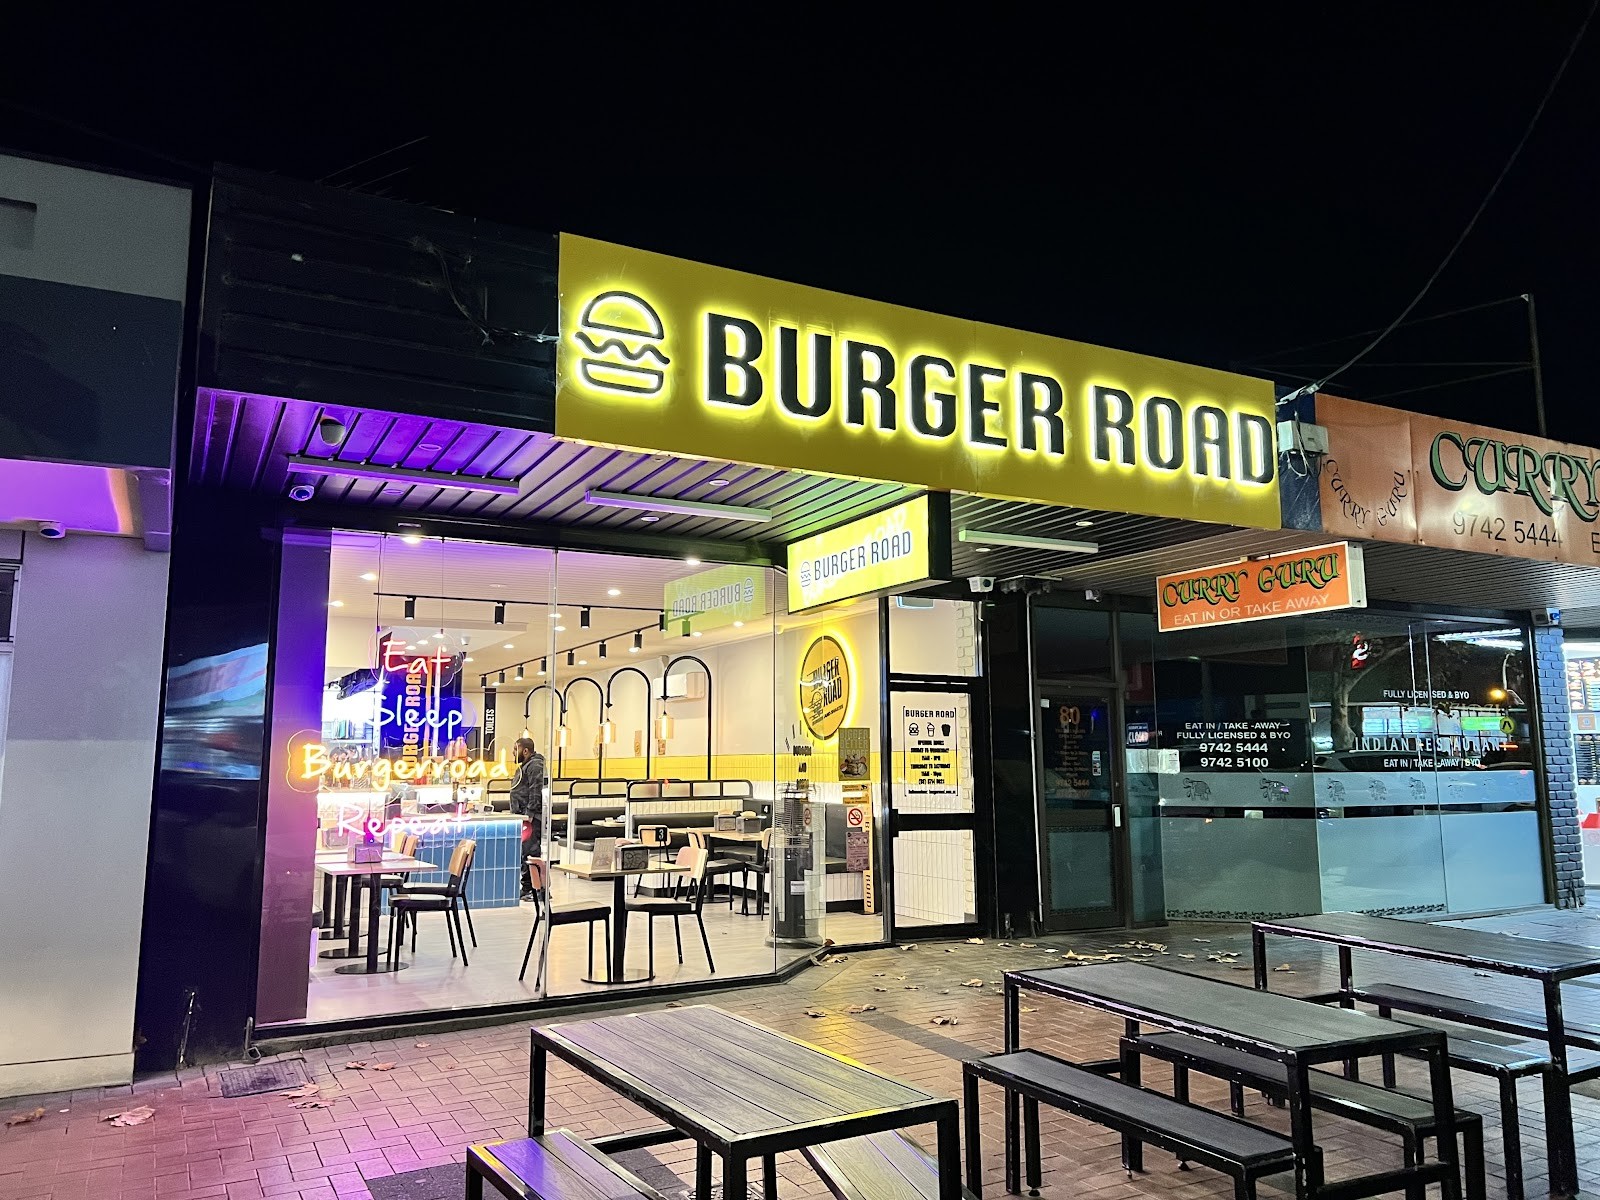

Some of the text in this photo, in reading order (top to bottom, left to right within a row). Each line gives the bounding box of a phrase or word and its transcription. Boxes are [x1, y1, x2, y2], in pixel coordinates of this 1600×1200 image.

[706, 312, 1274, 484] BURGER ROAD
[1429, 430, 1600, 523] CURRY
[1324, 459, 1408, 529] CURRY GURU
[1453, 513, 1564, 549] 9742 5444
[814, 530, 912, 581] BURGER ROAD
[1162, 552, 1341, 607] CURRY GURU
[1174, 593, 1330, 625] EAT IN OR TAKE AWAY
[382, 638, 452, 674] Eat
[813, 656, 840, 691] BUGER
[1383, 689, 1406, 698] FULLY
[1454, 691, 1470, 700] BYO
[364, 694, 463, 740] Sleep
[485, 708, 495, 735] TOILETS
[905, 709, 955, 719] BURGER ROAD
[1060, 705, 1081, 725] 80
[1185, 722, 1204, 730] EAT
[1205, 722, 1216, 730] IN
[1223, 722, 1249, 730] TAKE
[1200, 743, 1269, 753] 9742 5444
[1355, 736, 1508, 752] INDIAN RESAURANT
[301, 743, 510, 791] Burgerroad
[1200, 758, 1269, 768] 9742 5100
[1383, 758, 1400, 768] EAT
[1400, 758, 1408, 768] IN
[1413, 758, 1434, 768] TAKE
[336, 803, 471, 843] Repeat
[763, 805, 768, 814] 4
[658, 828, 664, 841] 3
